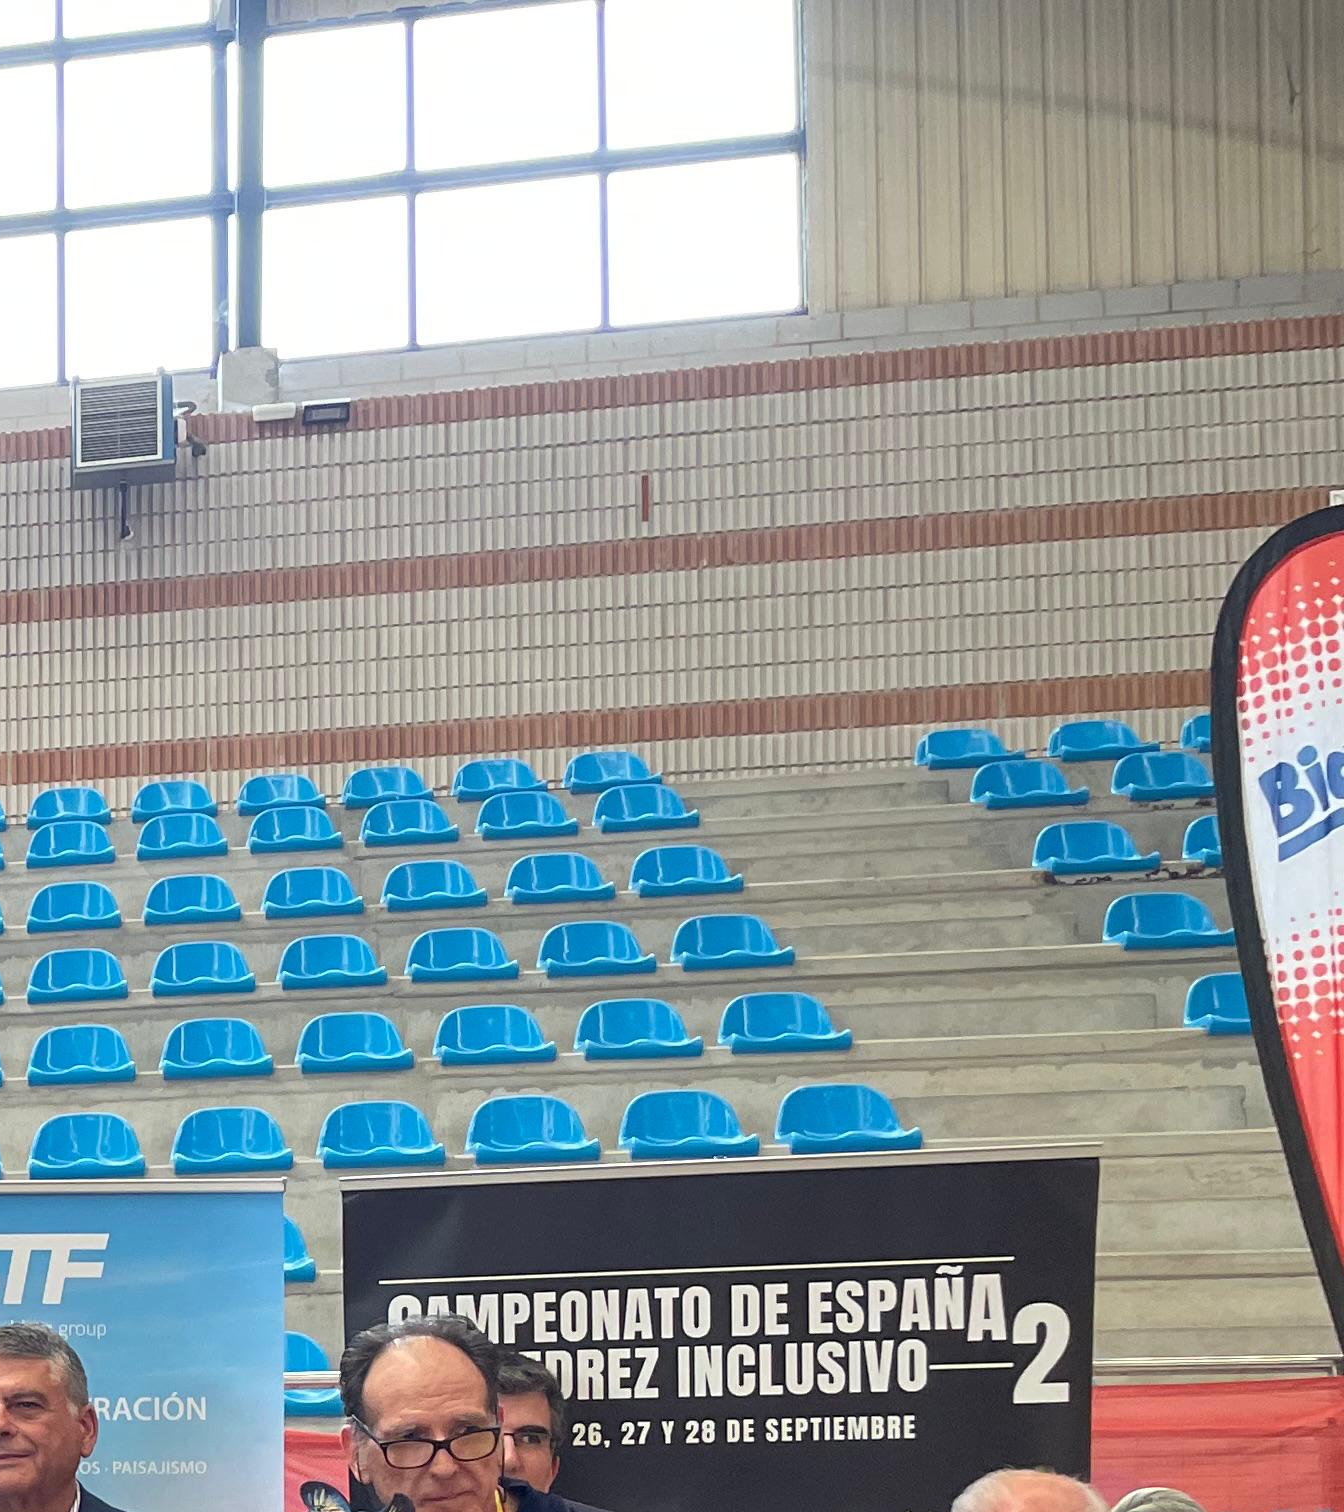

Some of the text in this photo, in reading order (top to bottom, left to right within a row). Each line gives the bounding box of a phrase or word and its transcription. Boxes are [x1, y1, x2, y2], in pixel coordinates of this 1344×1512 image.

[58, 1323, 107, 1340] group
[730, 1283, 790, 1338] DE
[808, 1264, 1008, 1343] ESPAÑA
[1012, 1302, 1071, 1405] 2
[518, 1338, 928, 1401] DREZ INCLUSIVO
[92, 1391, 207, 1422] RACIÓN
[571, 1414, 917, 1449] 26, 27 Y 28 DE SEPTIEMBRE
[112, 1460, 207, 1476] PAISAJISMO
